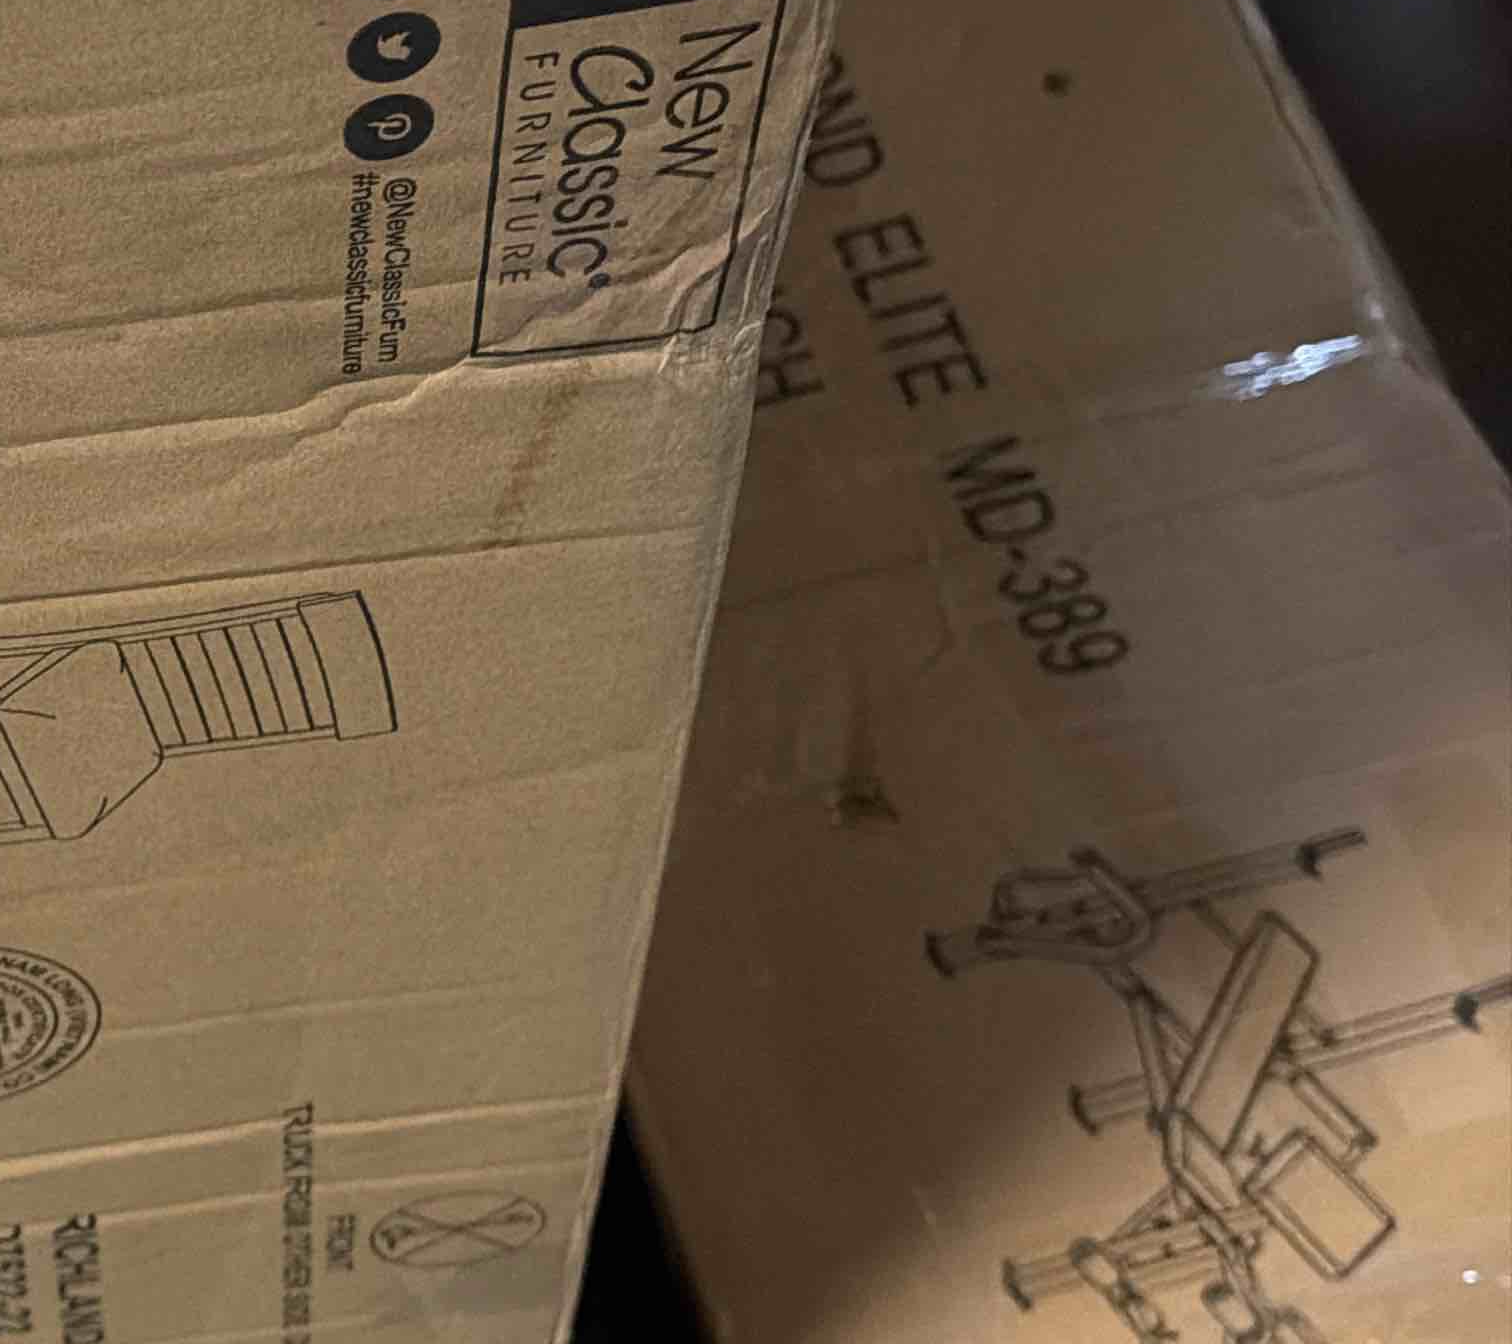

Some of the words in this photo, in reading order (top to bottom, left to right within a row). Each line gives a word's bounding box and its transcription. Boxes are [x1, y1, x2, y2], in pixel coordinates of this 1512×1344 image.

[499, 51, 560, 285] FURNITURE
[655, 22, 762, 181] New
[342, 172, 380, 375] #newclassicfurniture
[834, 213, 987, 408] ELITE
[945, 434, 1129, 677] MD-389
